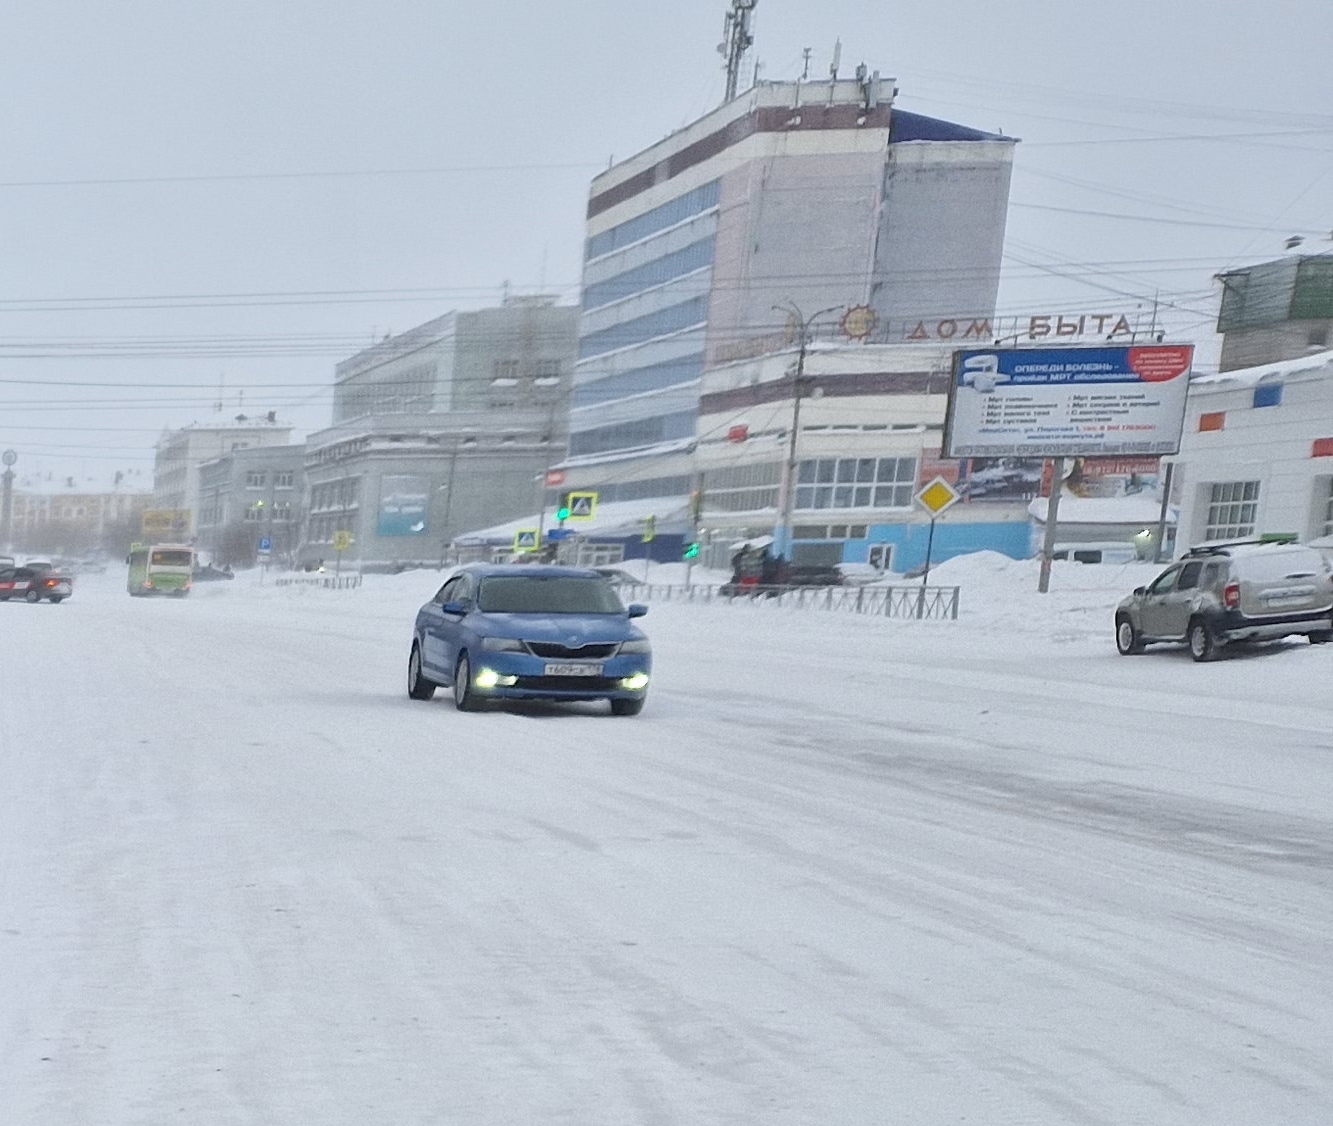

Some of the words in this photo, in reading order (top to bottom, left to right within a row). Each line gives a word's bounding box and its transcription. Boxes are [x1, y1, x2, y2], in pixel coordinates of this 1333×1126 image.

[907, 318, 994, 340] ДОМ
[1029, 313, 1132, 340] БЫТА
[1014, 364, 1064, 373] ОПЕРЕДИ
[1065, 363, 1113, 372] БОЛЕЗНЬ
[1050, 373, 1072, 381] МРТ
